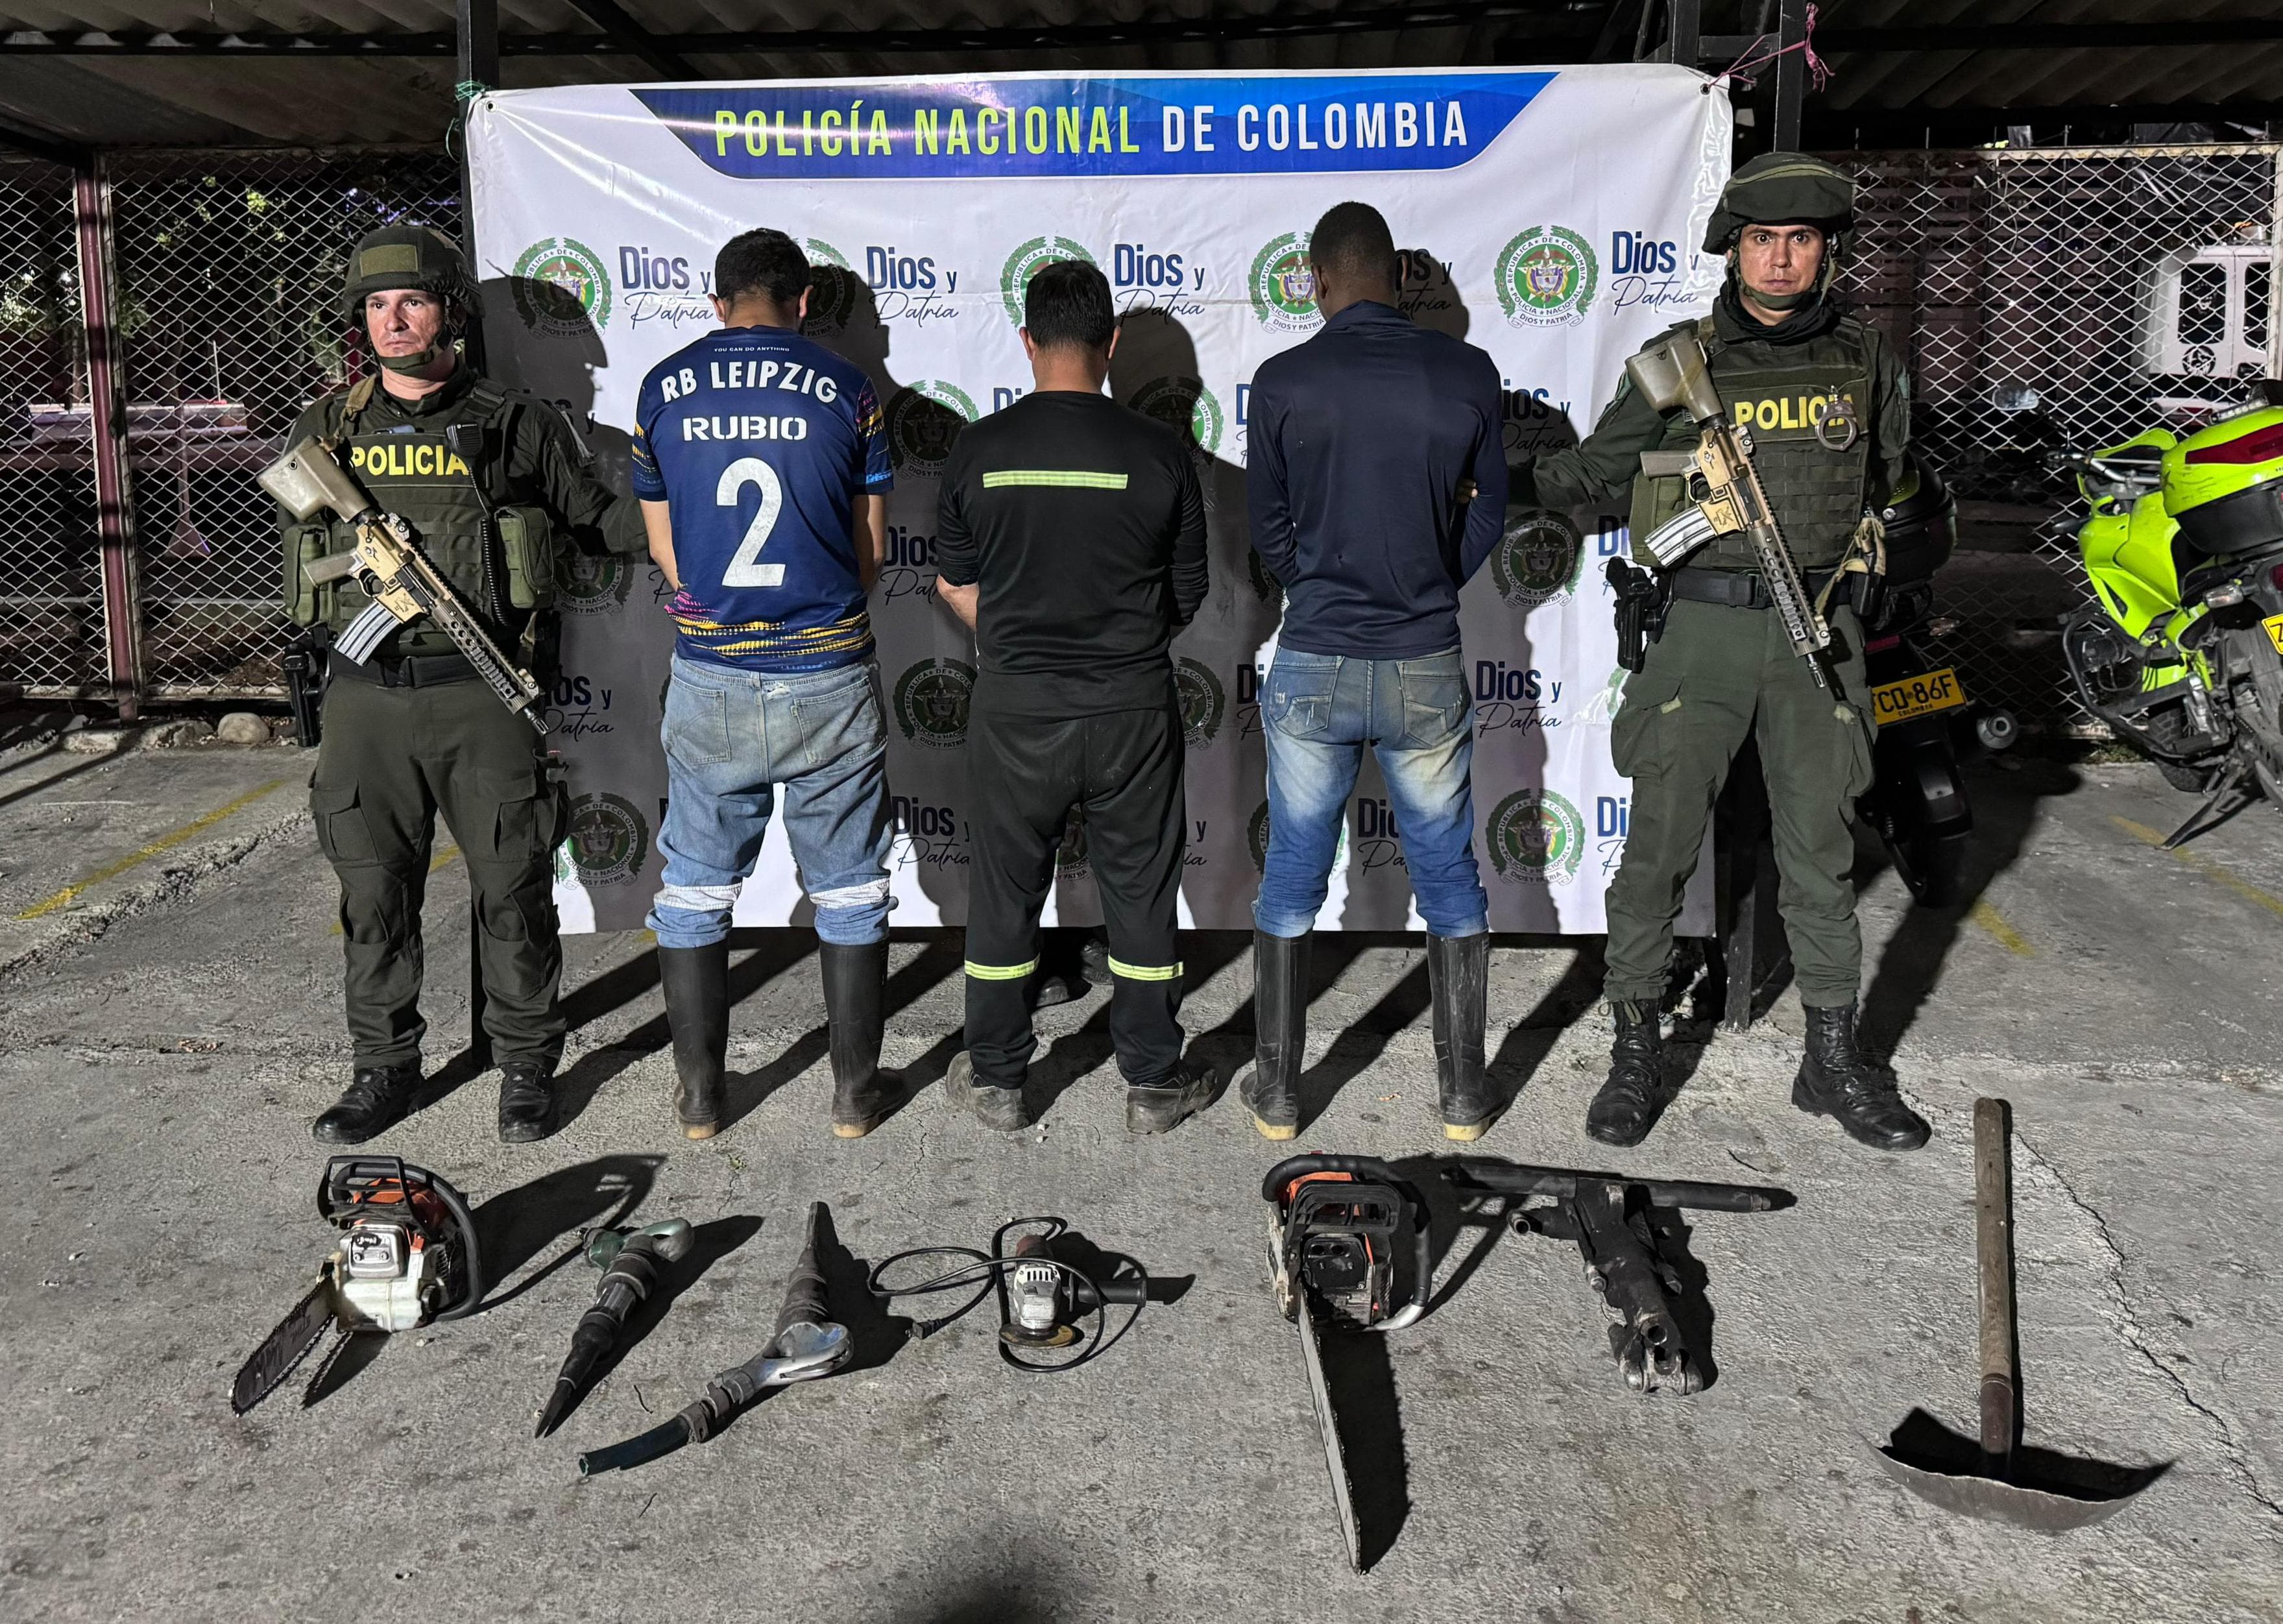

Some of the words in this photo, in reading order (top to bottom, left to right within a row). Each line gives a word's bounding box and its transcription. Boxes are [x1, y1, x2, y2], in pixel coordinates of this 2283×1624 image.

[716, 101, 892, 157] POLICÍA
[915, 106, 1140, 156] NACIONAL
[1163, 104, 1214, 152] DE
[1237, 100, 1468, 151] COLOMBIA
[619, 247, 690, 289] Dios
[700, 272, 710, 294] y
[866, 247, 936, 289] Dios
[947, 271, 957, 293] y
[1115, 244, 1183, 286] Dios
[1194, 268, 1205, 291] y
[1562, 241, 1586, 281] COLOMBIA
[1612, 231, 1676, 274] Dios
[575, 254, 601, 294] COLOMBIA
[1442, 262, 1452, 285] y
[625, 291, 714, 330] Patria
[869, 290, 959, 329] Patria
[1115, 287, 1205, 328] Patria
[1547, 291, 1582, 315] NACIONAL
[1612, 274, 1698, 315] Patria
[1299, 319, 1325, 330] PATRIA
[1547, 313, 1573, 324] PATRIA
[661, 367, 697, 403] RB
[710, 361, 837, 403] LEIPZIG
[1503, 379, 1549, 420] ios
[1560, 402, 1571, 424] y
[682, 415, 807, 441] RUBIO
[350, 444, 470, 476] POLICIA
[716, 457, 786, 587] 2
[601, 690, 611, 710] y
[1190, 672, 1213, 709] COLOMBIA
[1476, 661, 1541, 701] Dios
[1551, 682, 1562, 703] y
[1476, 700, 1562, 738] Patria
[612, 806, 636, 843] COLOMBIA
[892, 796, 955, 836] Dios
[1196, 821, 1207, 842] y
[1549, 803, 1573, 842] COLOMBIA
[601, 853, 634, 875] NACIONAL
[893, 837, 970, 871] Patria
[601, 873, 626, 885] PATRIA
